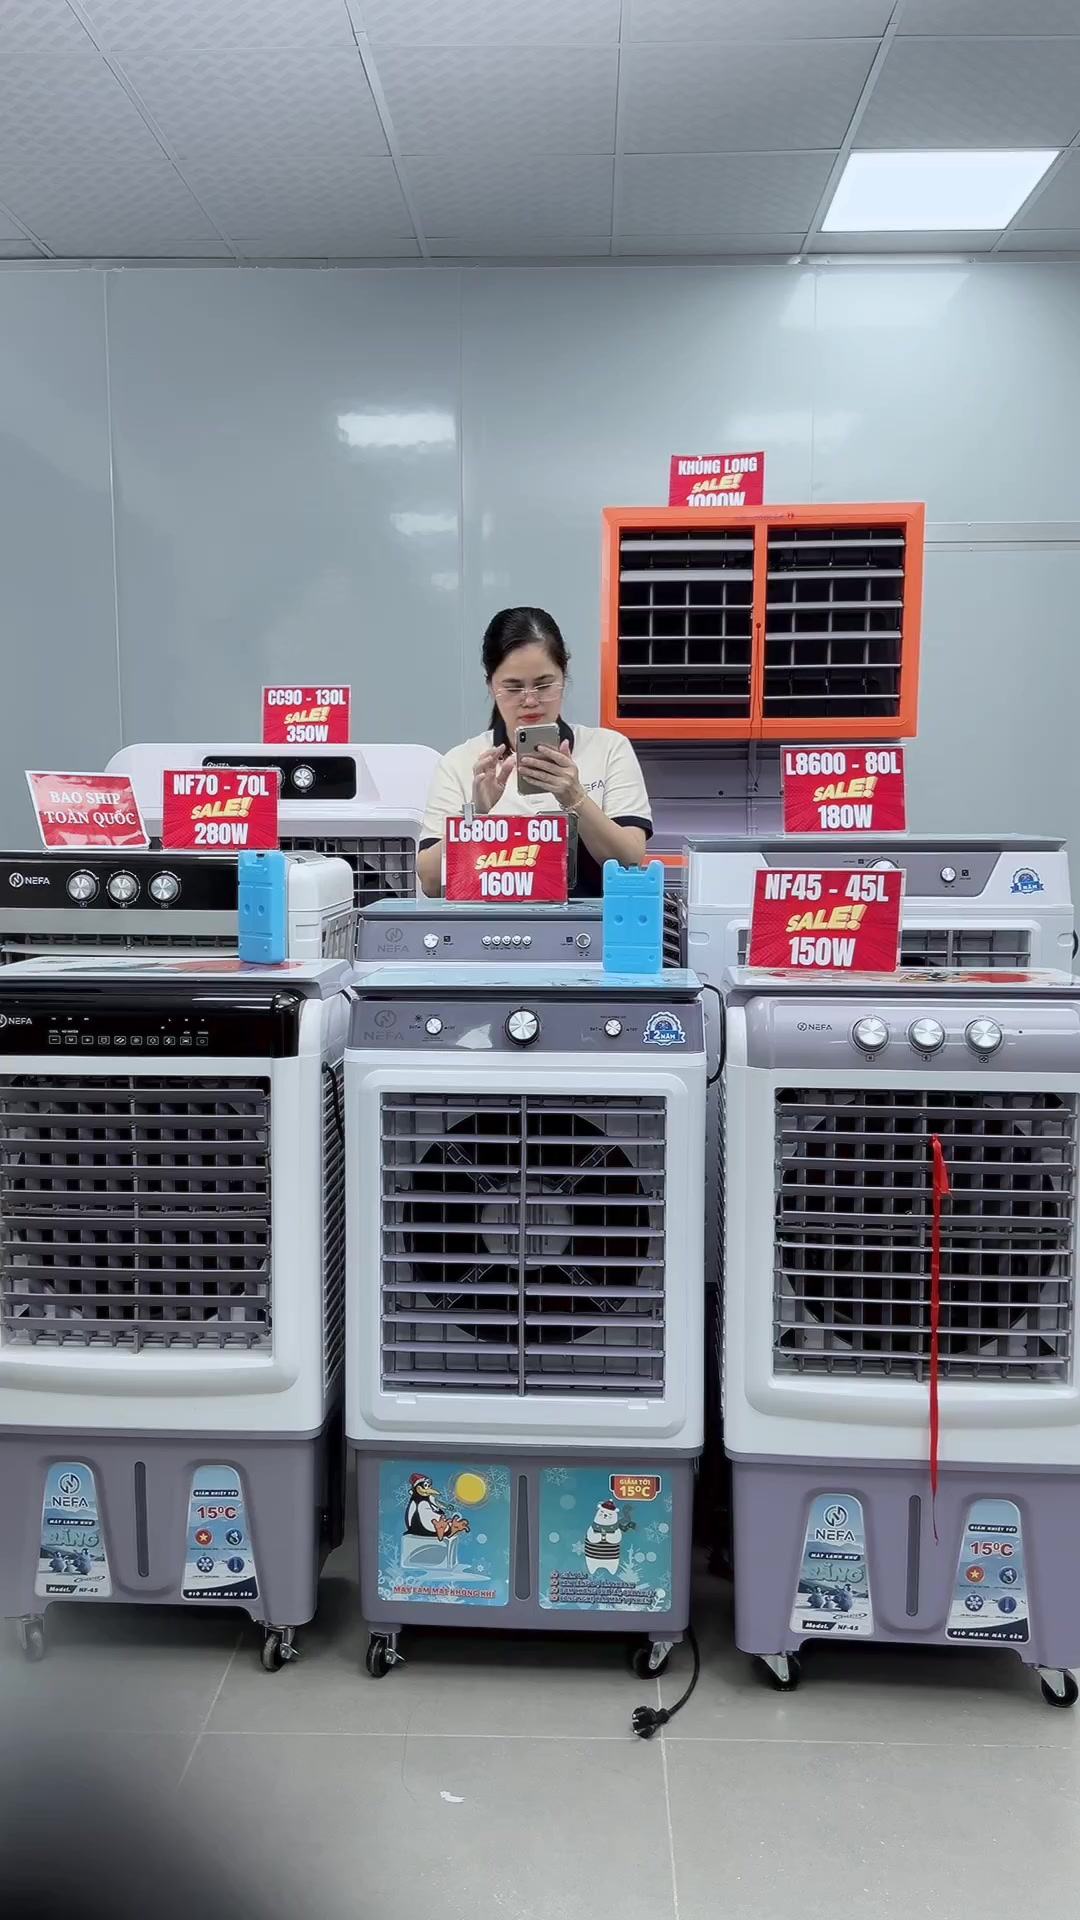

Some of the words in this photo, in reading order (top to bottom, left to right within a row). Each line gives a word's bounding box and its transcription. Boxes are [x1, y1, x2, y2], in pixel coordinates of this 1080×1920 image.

[678, 456, 720, 476] KHỦNG
[724, 457, 757, 474] LONG
[691, 473, 744, 494] SALE!
[268, 690, 303, 706] CC90
[315, 689, 347, 706] 130L
[283, 706, 331, 724] SALE!
[286, 725, 329, 742] 350W
[785, 752, 846, 776] L8600
[865, 751, 901, 774] 80L
[173, 774, 219, 796] NF70
[236, 774, 270, 797] 70L
[583, 780, 604, 791] EFA
[812, 776, 878, 802] SALE!
[49, 791, 83, 804] BAO
[86, 792, 120, 805] SHIP
[190, 796, 254, 820] SALE!
[43, 808, 90, 825] TOÀN
[93, 809, 137, 828] QUỐC
[818, 804, 873, 829] 180W
[194, 822, 249, 845] 280W
[449, 820, 509, 843] L6800
[527, 820, 563, 843] 60L
[474, 844, 541, 870] SALE!
[25, 876, 51, 885] NEFA
[479, 871, 534, 897] 160W
[765, 873, 822, 901] NF45
[845, 874, 889, 902] 45L
[785, 904, 868, 933] SALE!
[377, 944, 410, 953] NEFA
[789, 936, 857, 967] 150W
[8, 1017, 33, 1025] NEFA
[808, 1023, 833, 1031] NEFA
[363, 1031, 405, 1041] NEFA
[653, 1030, 661, 1040] 2
[660, 1032, 676, 1040] NĂM
[52, 1496, 89, 1508] NEFA
[46, 1528, 100, 1548] BĂNG
[815, 1529, 855, 1541] NEFA
[805, 1562, 864, 1583] BĂNG
